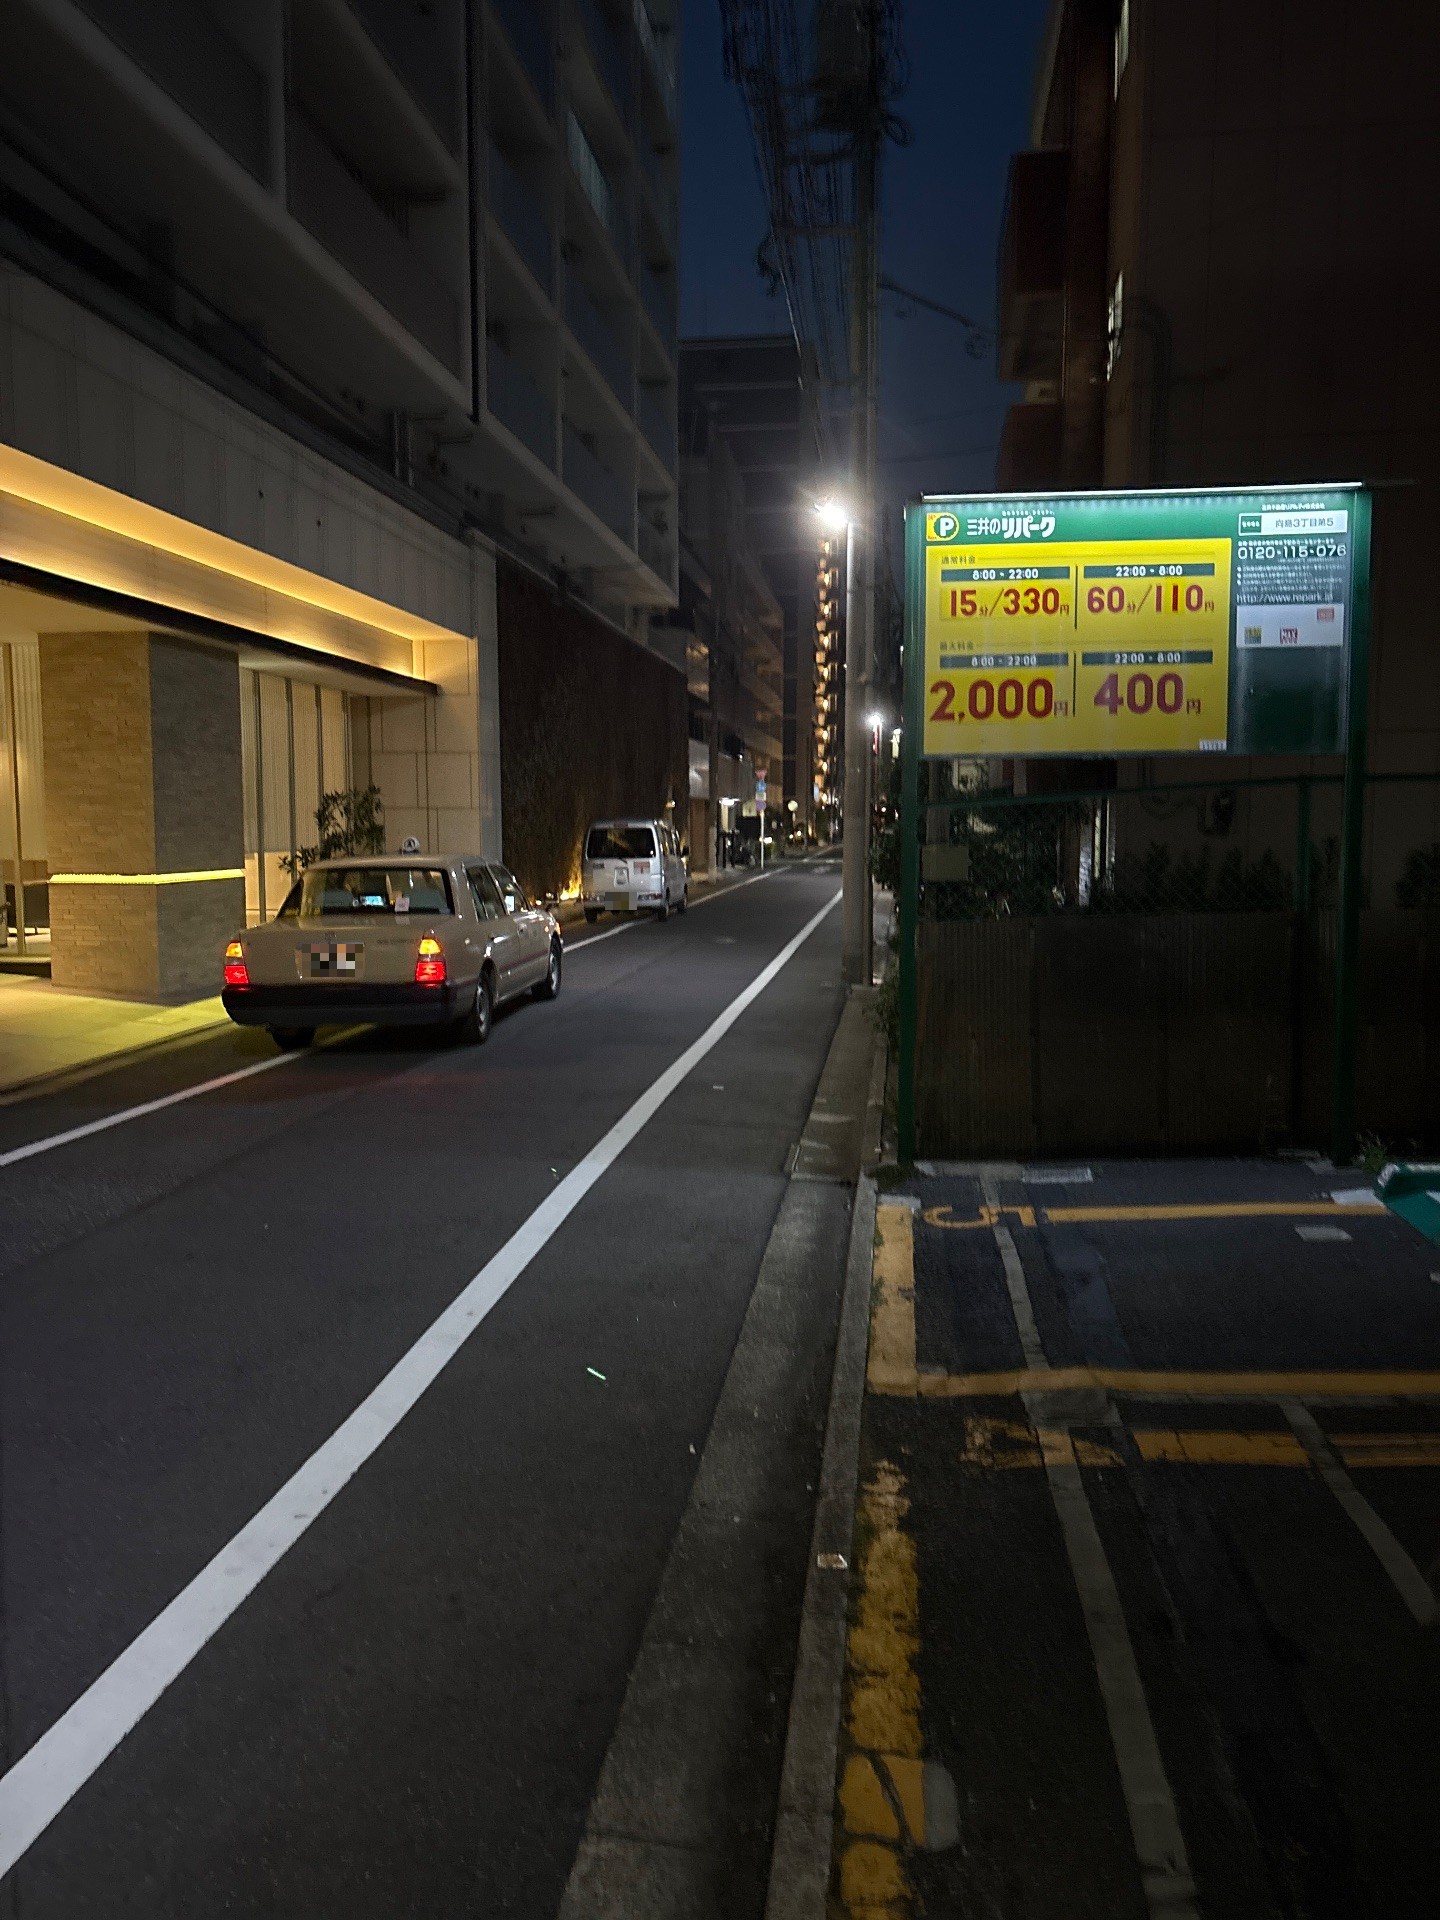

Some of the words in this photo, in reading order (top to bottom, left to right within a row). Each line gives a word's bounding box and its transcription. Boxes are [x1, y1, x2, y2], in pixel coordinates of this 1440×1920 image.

[966, 514, 1056, 539] 三井のリパーク
[972, 569, 996, 580] 8:00
[1008, 568, 1039, 580] 22:00
[1115, 566, 1146, 577] 22:00
[1158, 565, 1183, 576] 8:00
[971, 656, 995, 667] 8:00
[1007, 655, 1038, 667] 22:00
[1114, 653, 1145, 664] 22:00
[1157, 652, 1182, 663] 8:00
[929, 677, 1069, 724] 2,000円
[1094, 672, 1203, 717] 400円
